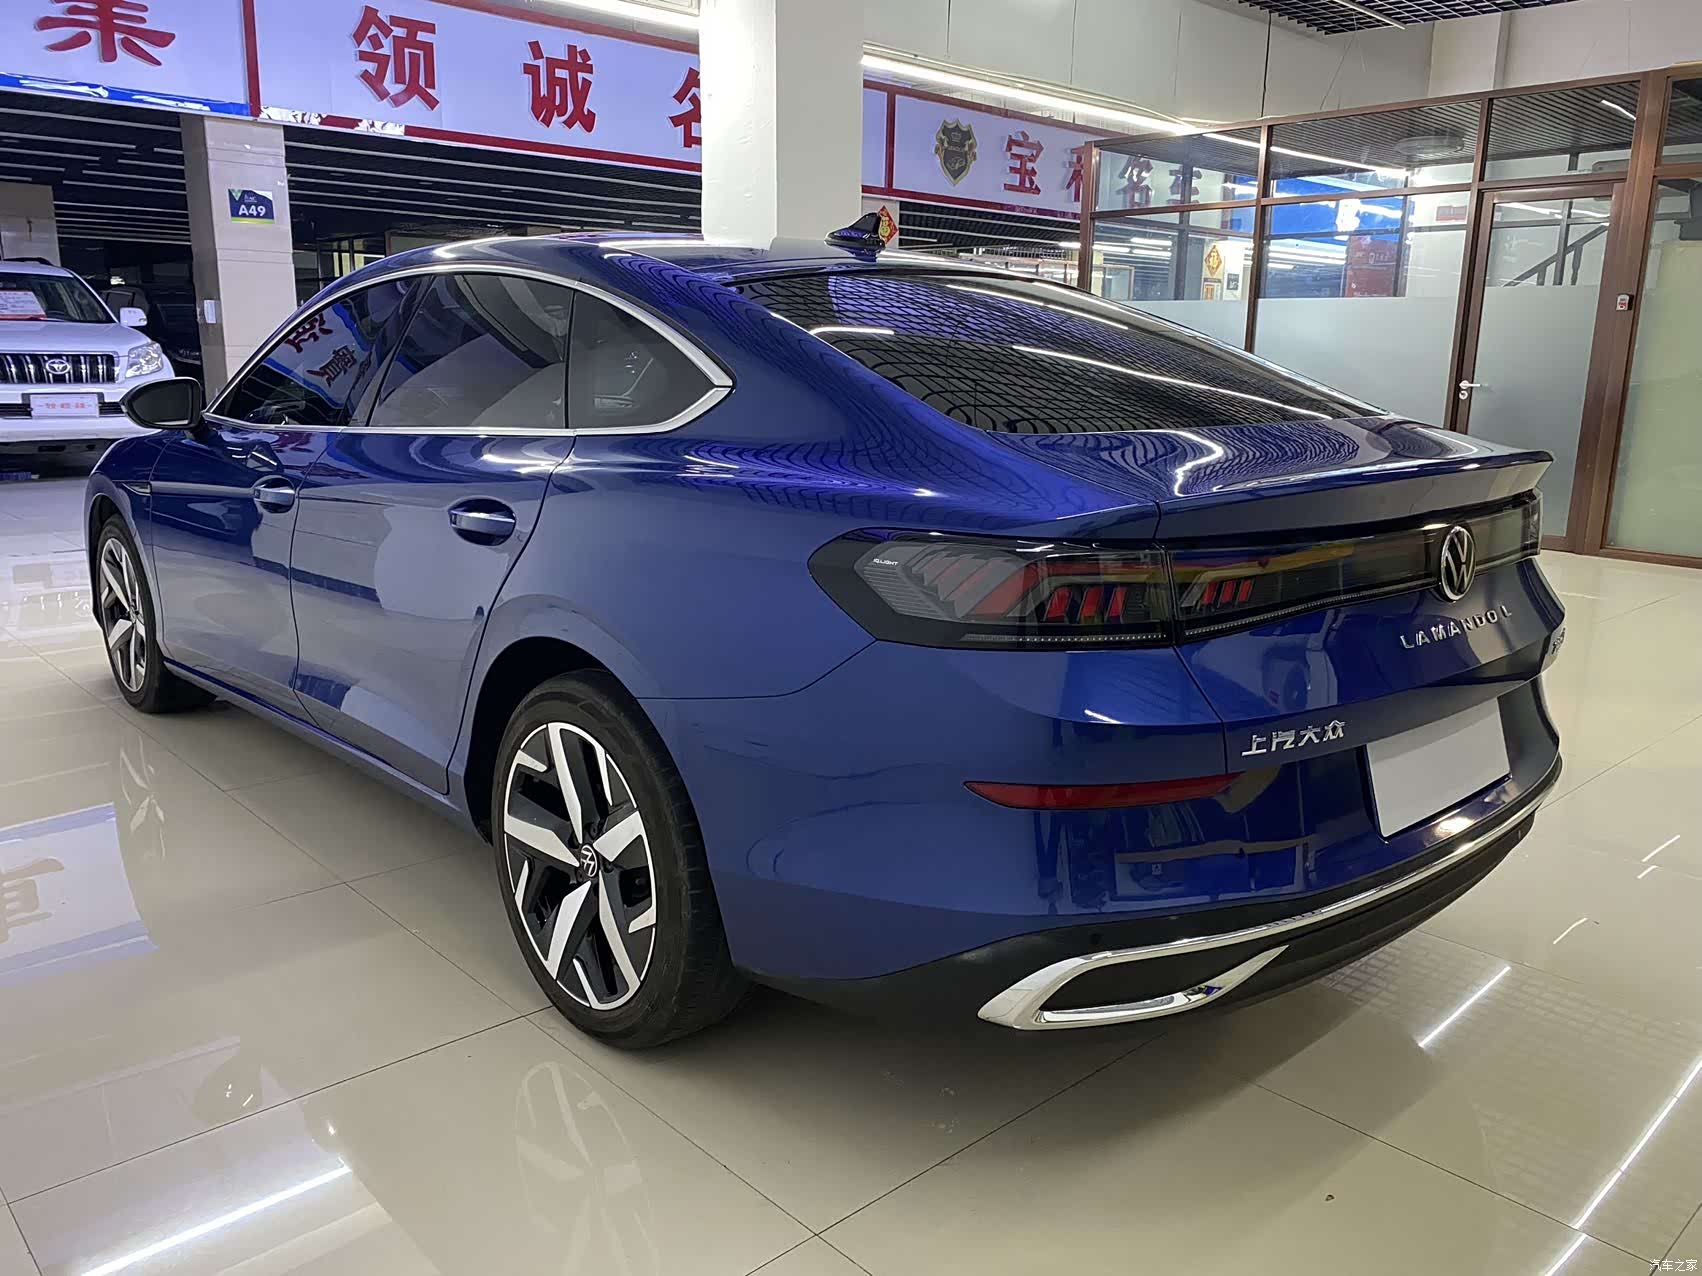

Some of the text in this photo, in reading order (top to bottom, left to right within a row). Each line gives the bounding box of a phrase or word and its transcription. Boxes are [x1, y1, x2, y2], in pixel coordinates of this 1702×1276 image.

[238, 204, 267, 217] A49
[1400, 609, 1498, 649] LAMANDO
[1241, 719, 1346, 757] 上汽大众
